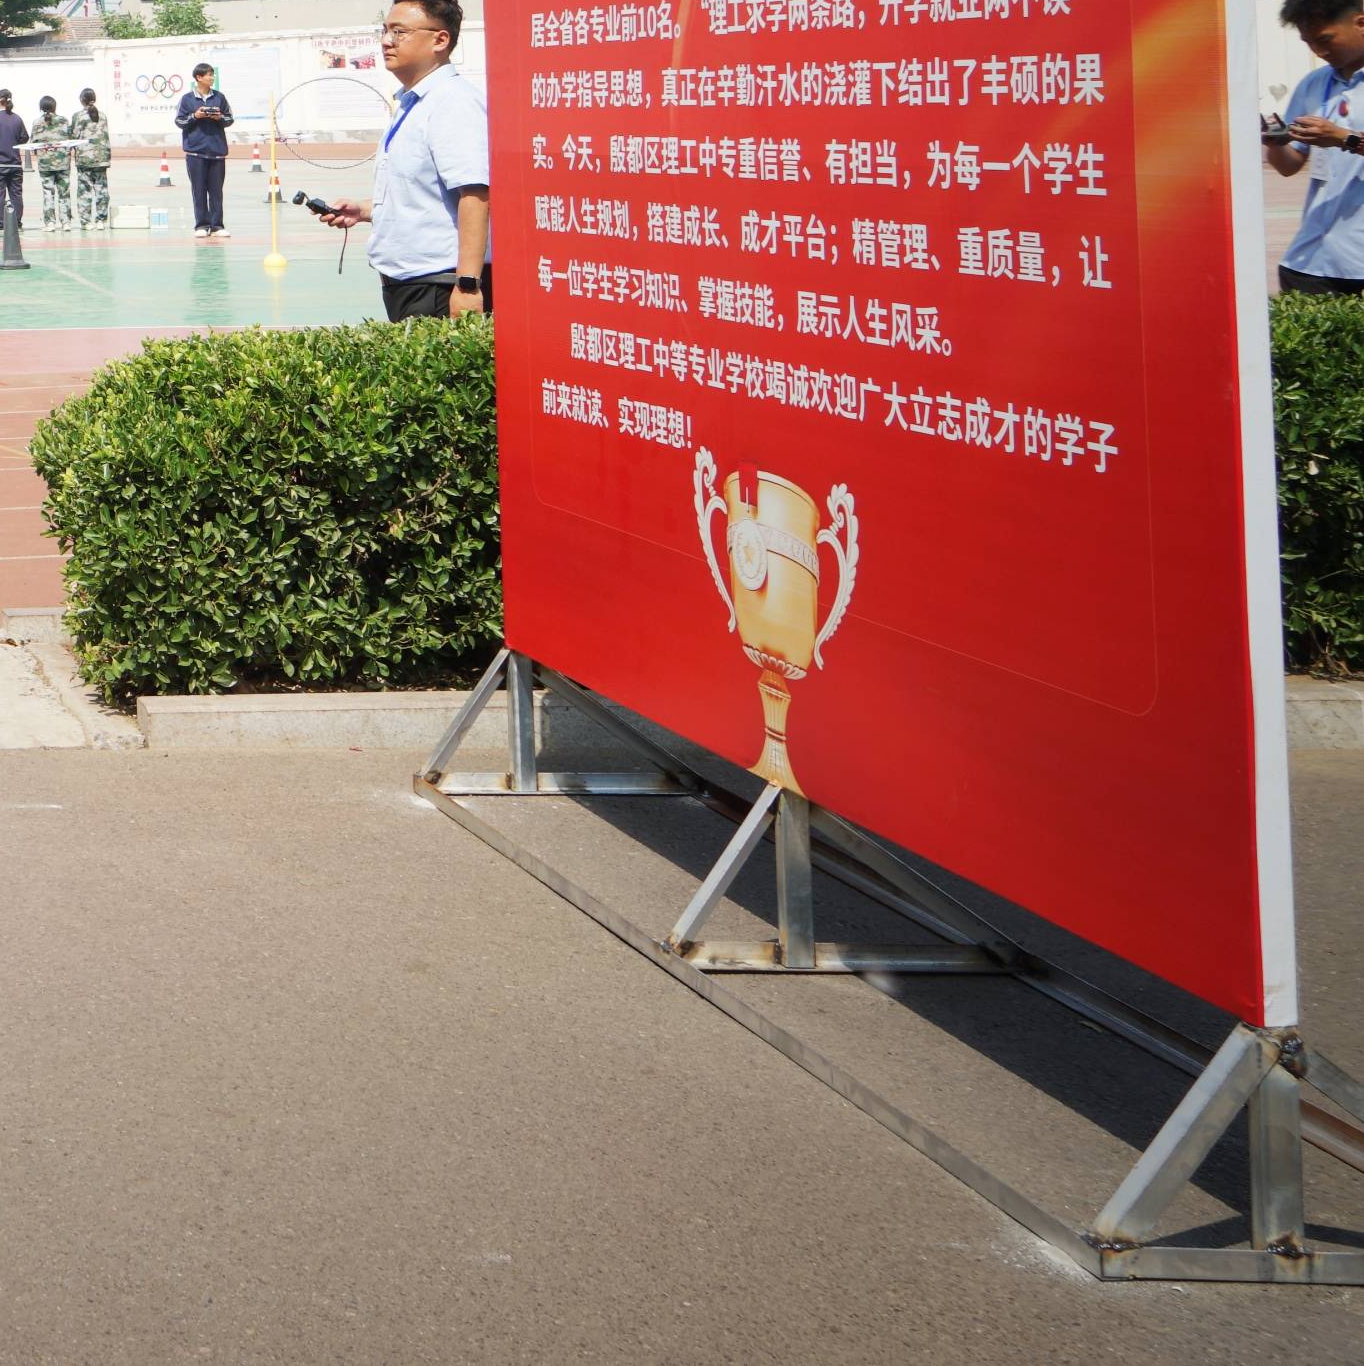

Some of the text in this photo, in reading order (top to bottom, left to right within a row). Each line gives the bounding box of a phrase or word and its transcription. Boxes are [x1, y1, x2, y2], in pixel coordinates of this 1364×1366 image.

[532, 53, 1102, 107] 的办学指导思想，真正在辛勤汗水的浇灌下结出了丰硕的果
[533, 134, 1105, 194] 实。今天，殷都区理工中专重信誉、有担当，为每一个学生
[538, 256, 950, 354] 每一位学生学习知识、掌握技能，展示人生风采。
[571, 323, 1116, 471] 殷都区理工中等专业学校竭诚欢迎广大立志成才的学子
